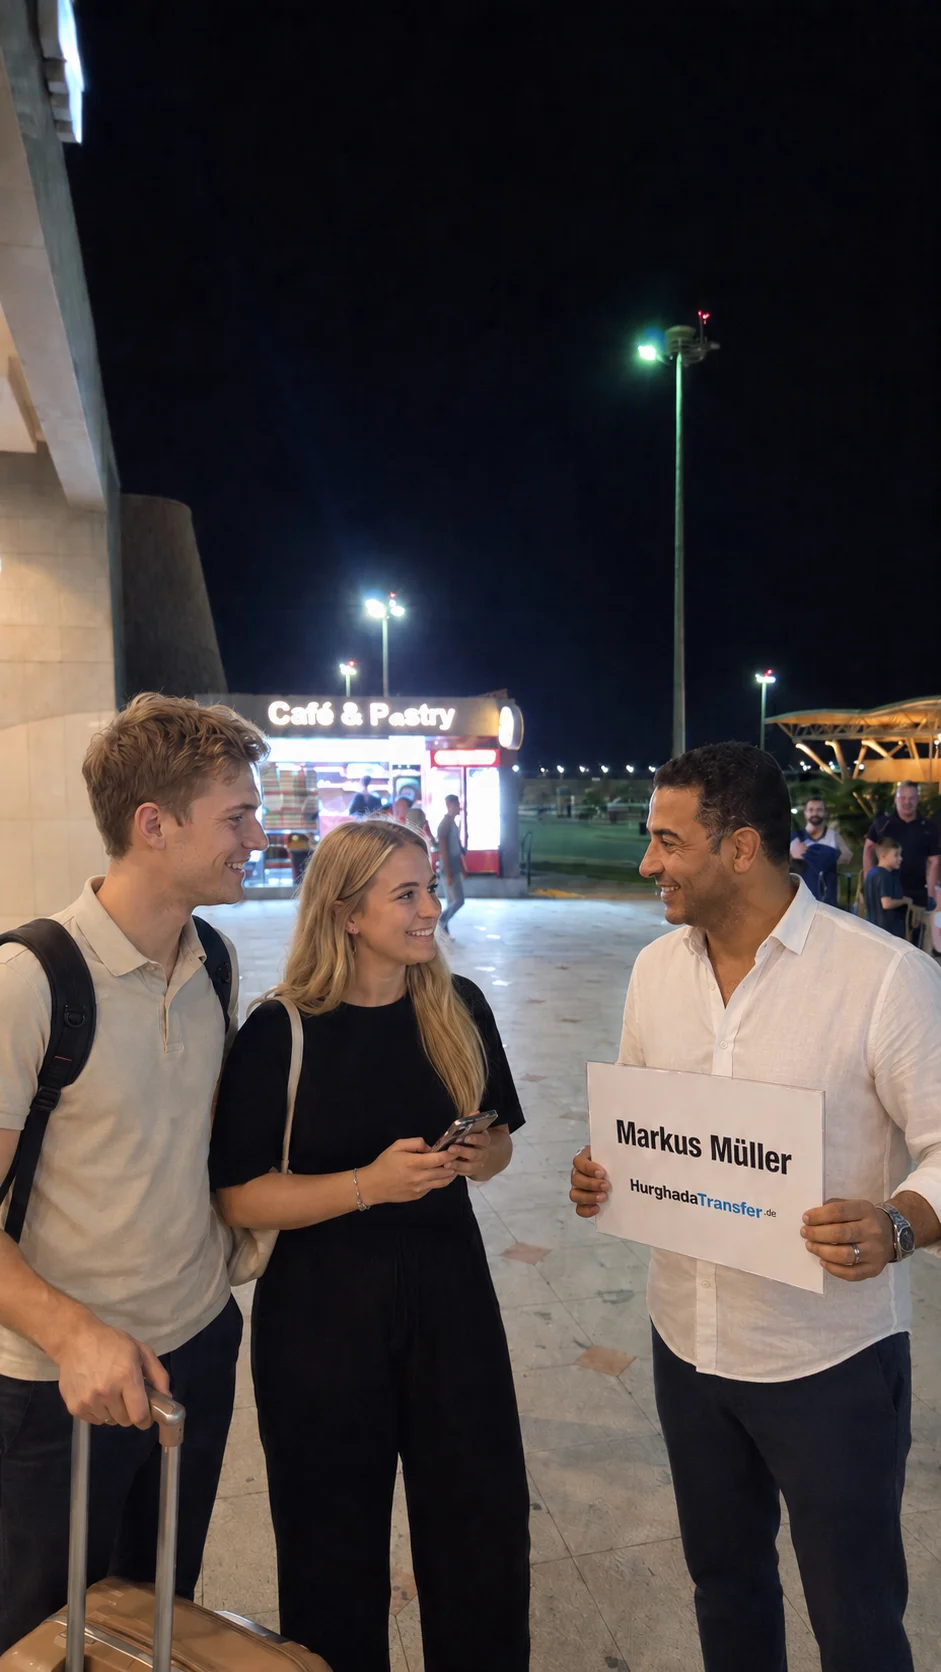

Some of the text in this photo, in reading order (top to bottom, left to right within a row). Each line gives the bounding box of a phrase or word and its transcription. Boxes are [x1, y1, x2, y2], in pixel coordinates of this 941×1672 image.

[267, 700, 457, 731] Café & Pastry
[616, 1119, 792, 1175] Markus Müller
